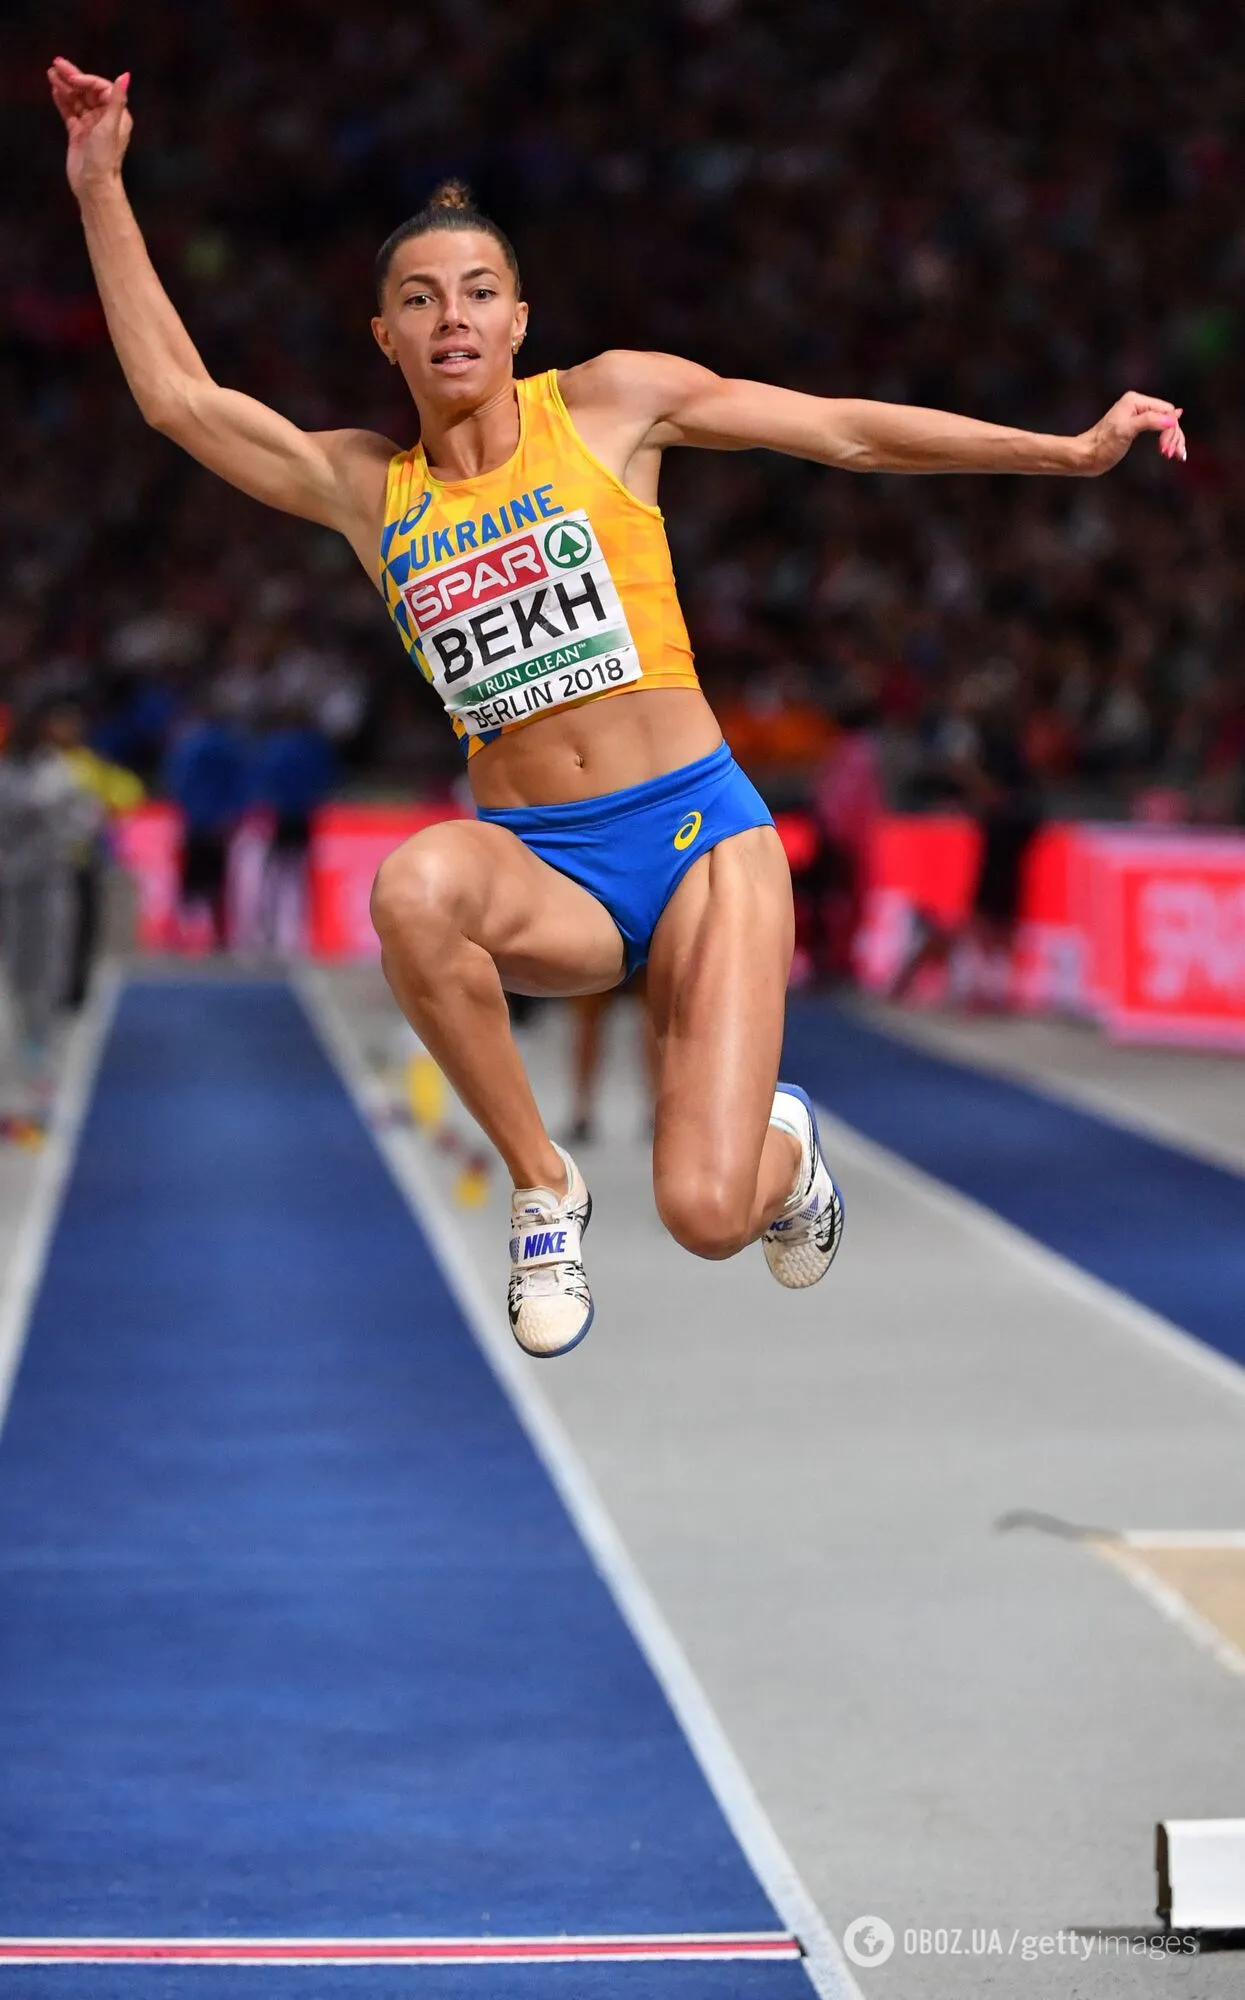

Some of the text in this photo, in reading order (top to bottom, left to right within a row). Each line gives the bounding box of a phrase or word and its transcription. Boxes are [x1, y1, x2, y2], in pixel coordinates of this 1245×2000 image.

[410, 484, 565, 570] UKRAINE
[411, 543, 542, 623] SPAR
[431, 572, 607, 684] BEKH
[467, 657, 624, 729] BERLIN 2018
[484, 669, 520, 693] RUN
[524, 1231, 567, 1260] NIKE
